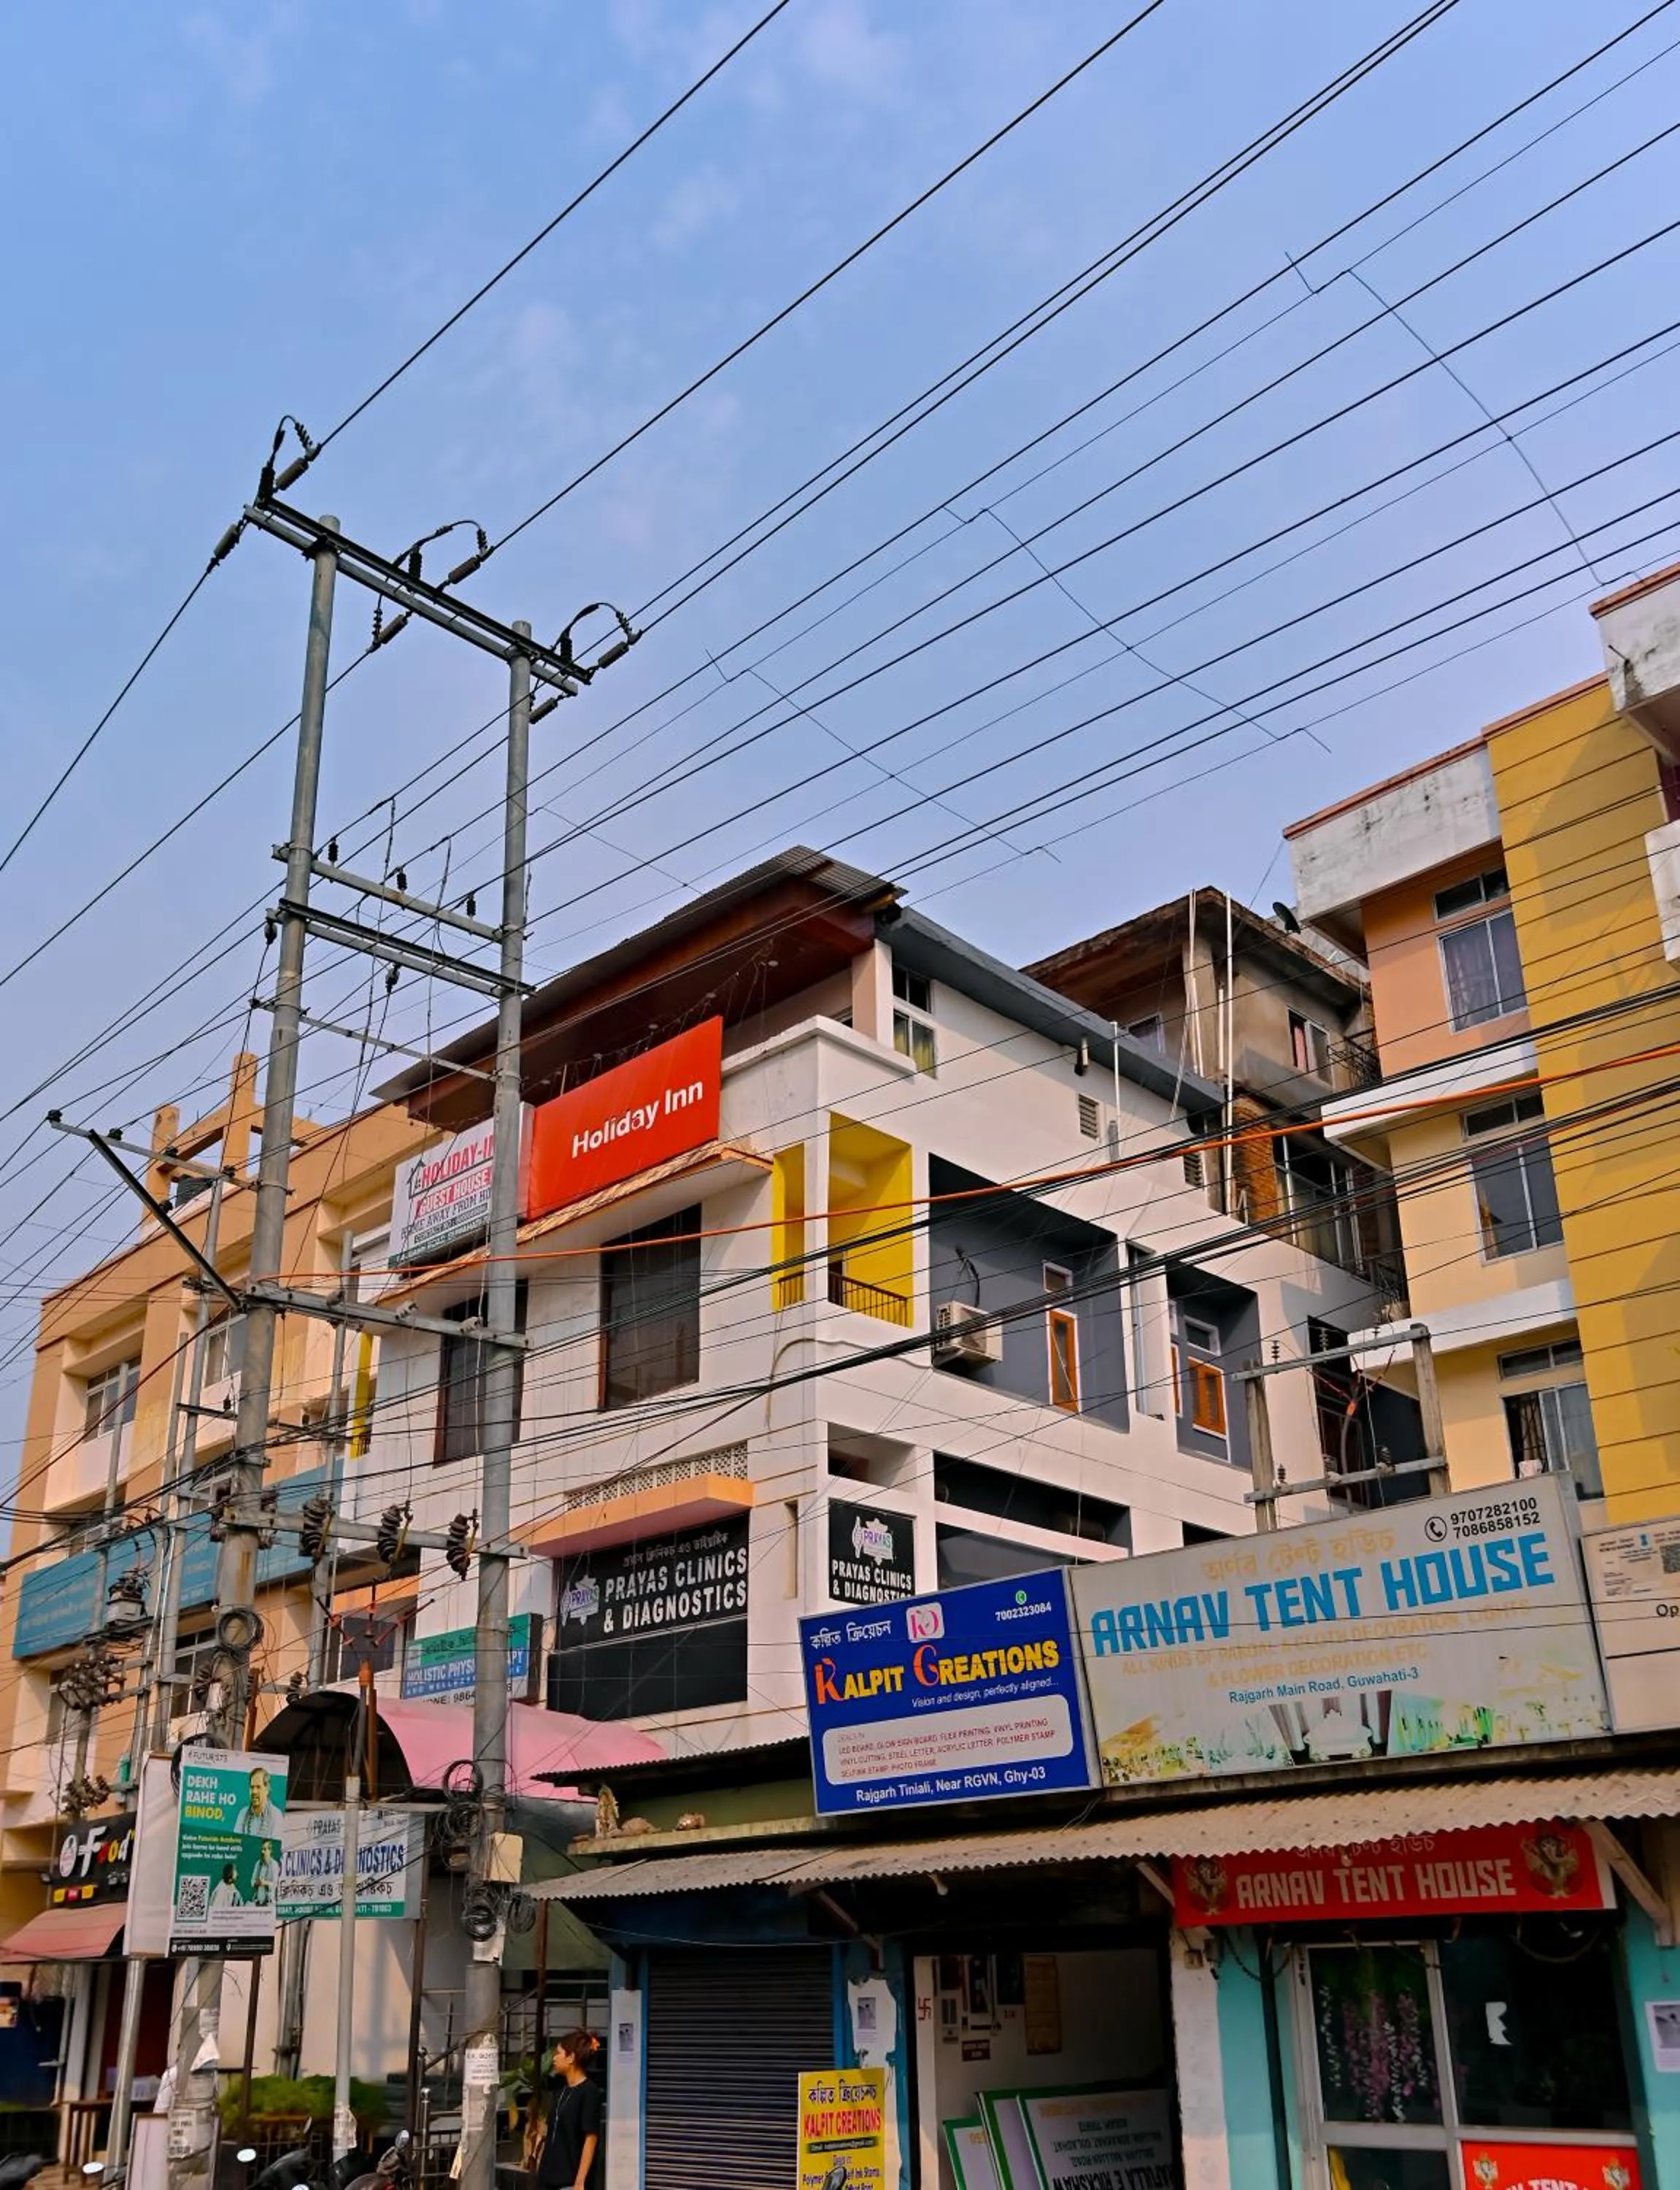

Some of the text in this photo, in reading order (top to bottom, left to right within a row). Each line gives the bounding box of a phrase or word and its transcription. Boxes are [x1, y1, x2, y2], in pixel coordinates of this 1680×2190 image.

[572, 1081, 703, 1159] Holiday Inn
[420, 1167, 491, 1215] GUEST HOUSE
[427, 1206, 451, 1230] AWAY
[452, 1195, 478, 1217] FROM
[1450, 1497, 1537, 1525] 9707282100
[1453, 1512, 1541, 1539] 7086858152
[863, 1529, 891, 1548] PRAYAS
[605, 1547, 747, 1603] PRAYAS CLINICS
[833, 1559, 912, 1591] PRAYAS CLINICS
[833, 1579, 911, 1602] & DIAGNOST
[571, 1585, 599, 1607] PRAYAS
[604, 1580, 747, 1634] & DIAGNOSTICS
[1091, 1532, 1555, 1657] ARNAV TENT HOUSE
[995, 1602, 1052, 1621] 7002323084
[1657, 1604, 1679, 1618] Op
[1122, 1659, 1147, 1675] ALL
[1149, 1651, 1192, 1670] KINDS
[1195, 1651, 1212, 1664] OF
[1467, 1599, 1531, 1622] LIGHTS
[407, 1666, 447, 1685] HOLISTIC
[814, 1657, 904, 1705] KALPIT
[1219, 1662, 1285, 1685] FLOWER
[1289, 1647, 1391, 1675] DECORATION
[912, 1697, 935, 1708] Vision
[937, 1693, 952, 1705] and
[953, 1688, 982, 1702] design,
[984, 1681, 1019, 1698] perfectly
[1229, 1667, 1419, 1705] Rajgarh Main Road, Guwahati-3
[839, 1746, 850, 1755] LED
[876, 1740, 895, 1750] GLOW
[898, 1738, 913, 1748] SIGN
[940, 1730, 956, 1741] FLEX
[993, 1724, 1013, 1734] VINYL
[1014, 1718, 1049, 1730] PRINTING
[840, 1756, 858, 1766] VINYL
[888, 1751, 908, 1761] STEEL
[937, 1743, 966, 1755] ACRYLIC
[996, 1734, 1030, 1745] POLYMER
[891, 1761, 912, 1772] PHOTO
[914, 1758, 937, 1769] FRAME
[186, 1790, 236, 1805] RAHE HO
[187, 1775, 217, 1789] DEKH
[856, 1787, 897, 1804] Rajgarh
[936, 1779, 961, 1793] Near
[964, 1772, 1003, 1788] RGVN,
[1004, 1765, 1047, 1786] Ghy-03
[185, 1805, 225, 1821] BINOD,
[313, 1818, 342, 1835] PRAYAS
[285, 1845, 404, 1877] CLINICS & DINOSTICS
[1236, 1859, 1517, 1909] ARNAV TENT HOUSE
[804, 2108, 881, 2138] KALPIT CREATIONS
